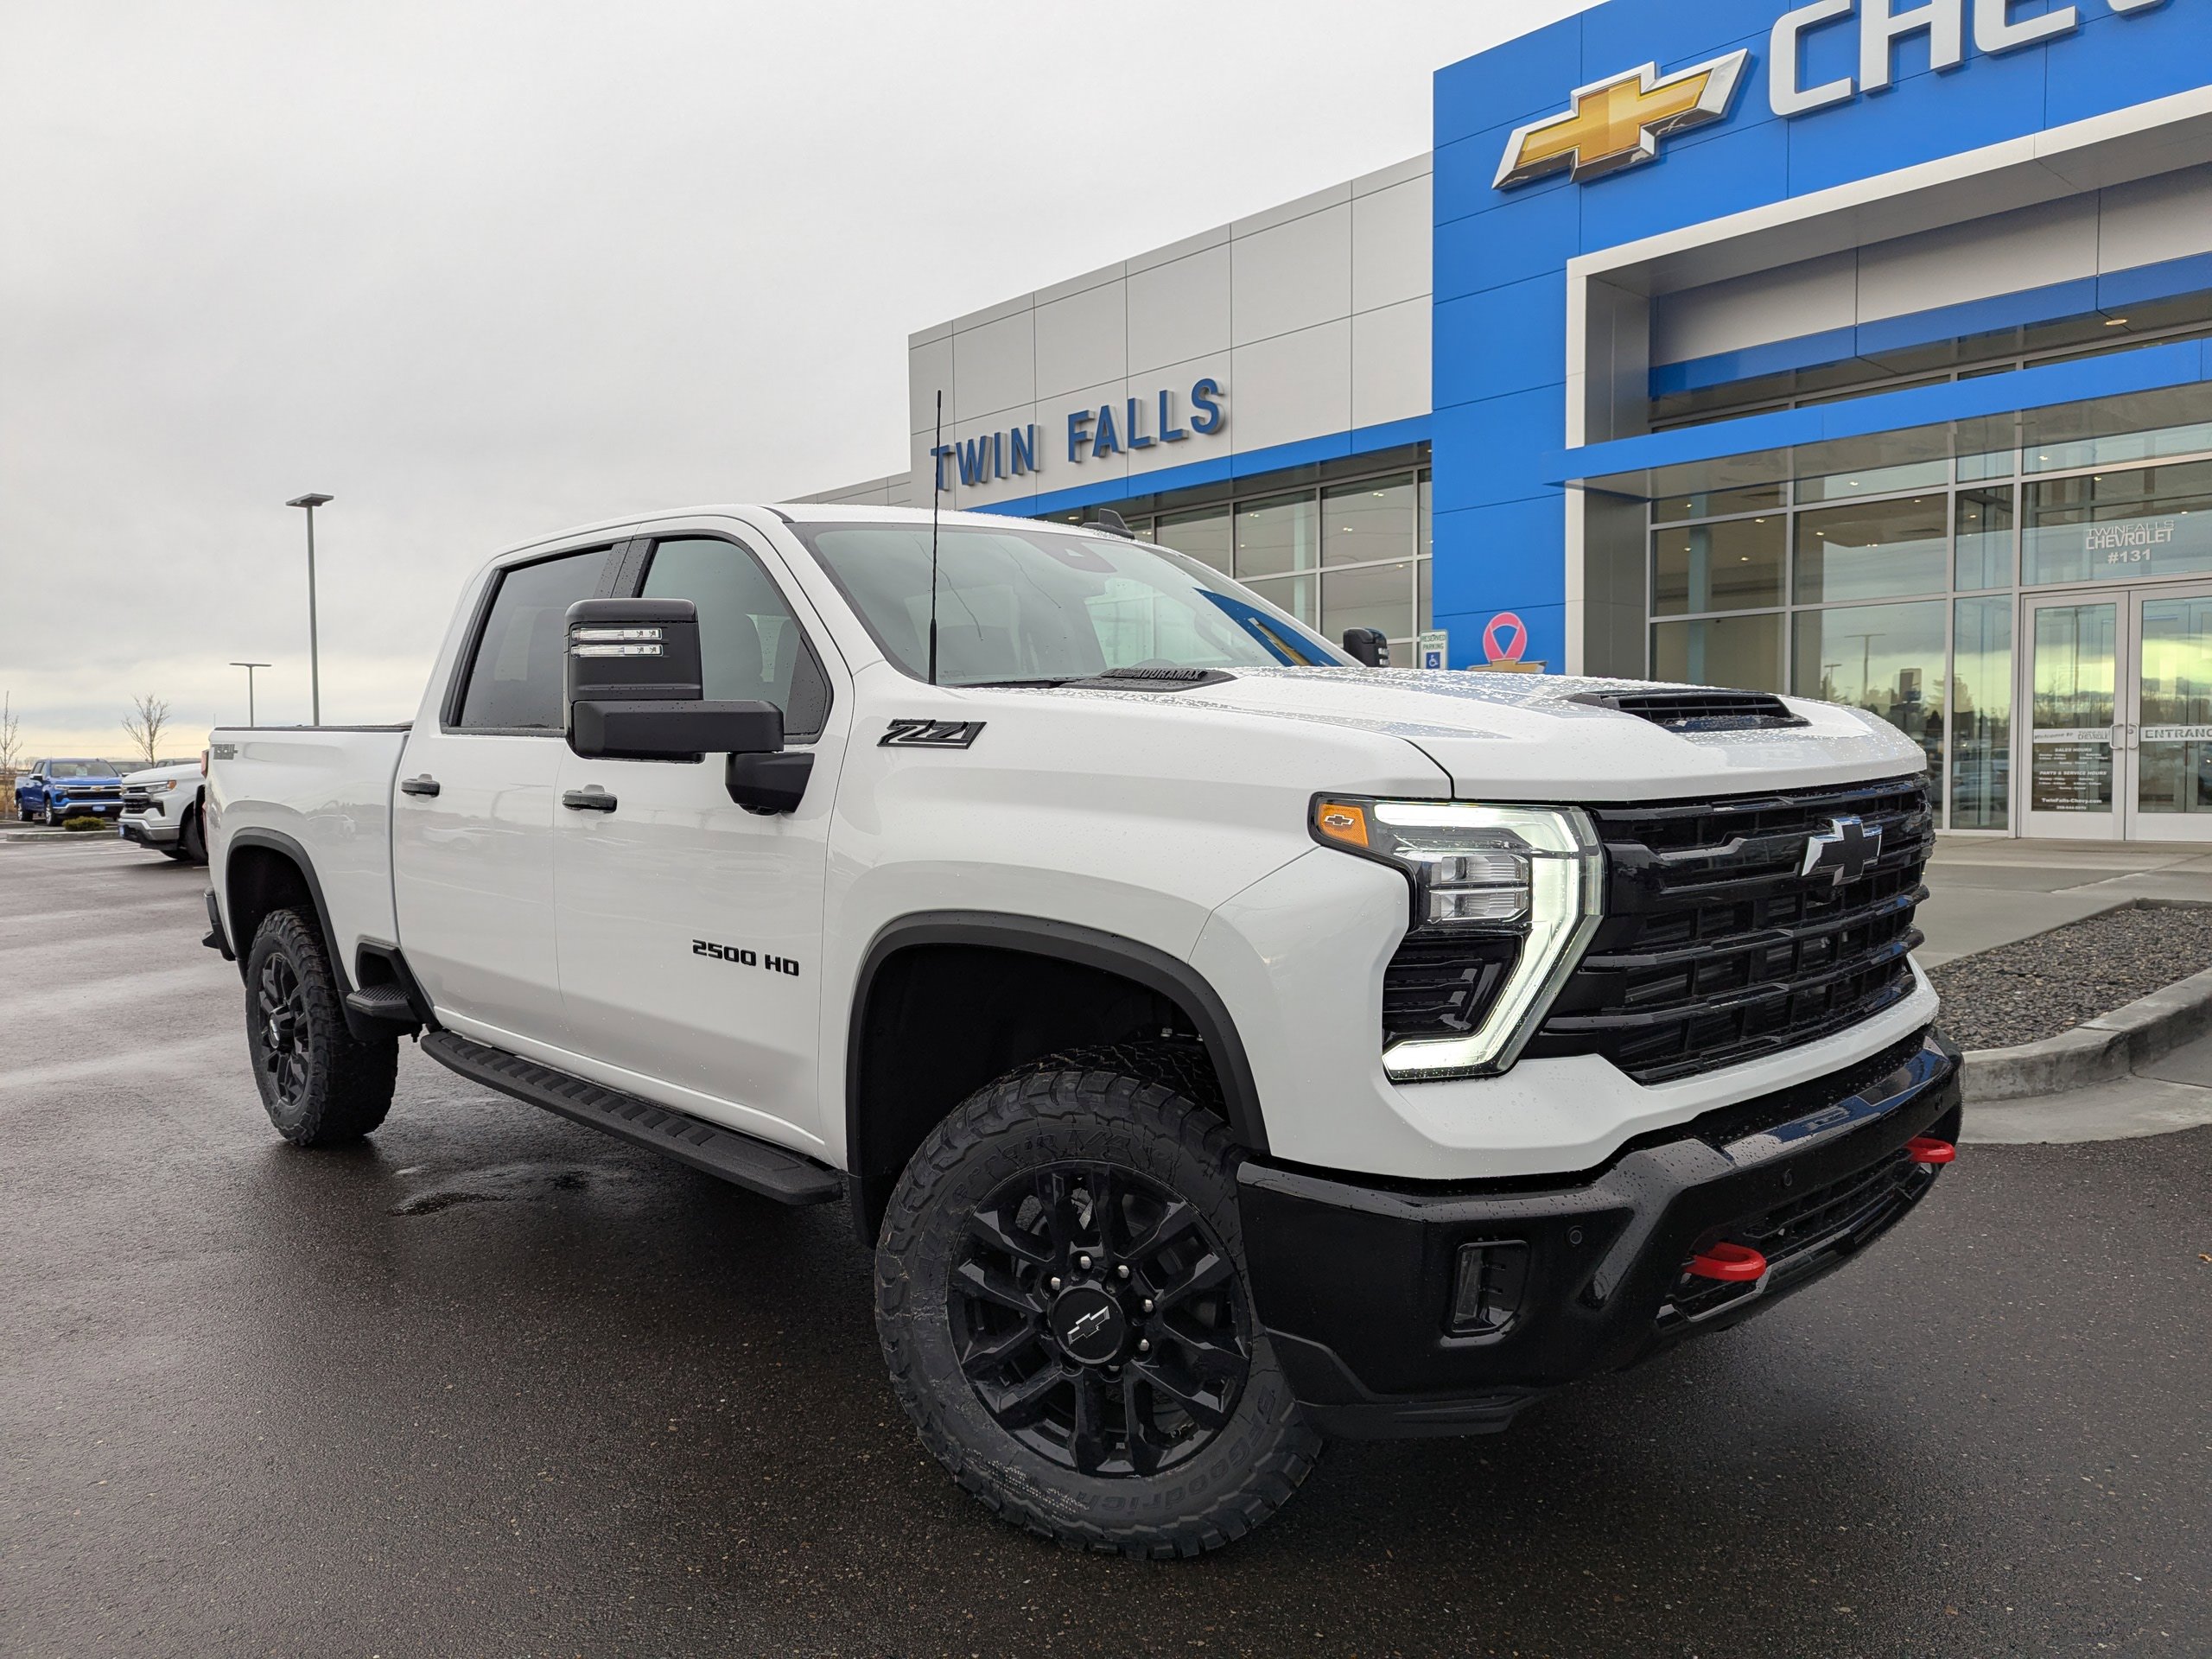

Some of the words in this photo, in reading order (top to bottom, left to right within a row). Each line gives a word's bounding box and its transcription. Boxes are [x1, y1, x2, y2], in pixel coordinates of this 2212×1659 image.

[931, 424, 1040, 492] TWIN
[1069, 378, 1224, 464] FALLS
[2086, 528, 2174, 550] CHEVROLET
[2108, 549, 2151, 564] #131
[1139, 669, 1205, 681] DURAMAX
[876, 719, 987, 749] Z71
[692, 939, 757, 967] 2500
[765, 954, 799, 976] HD
